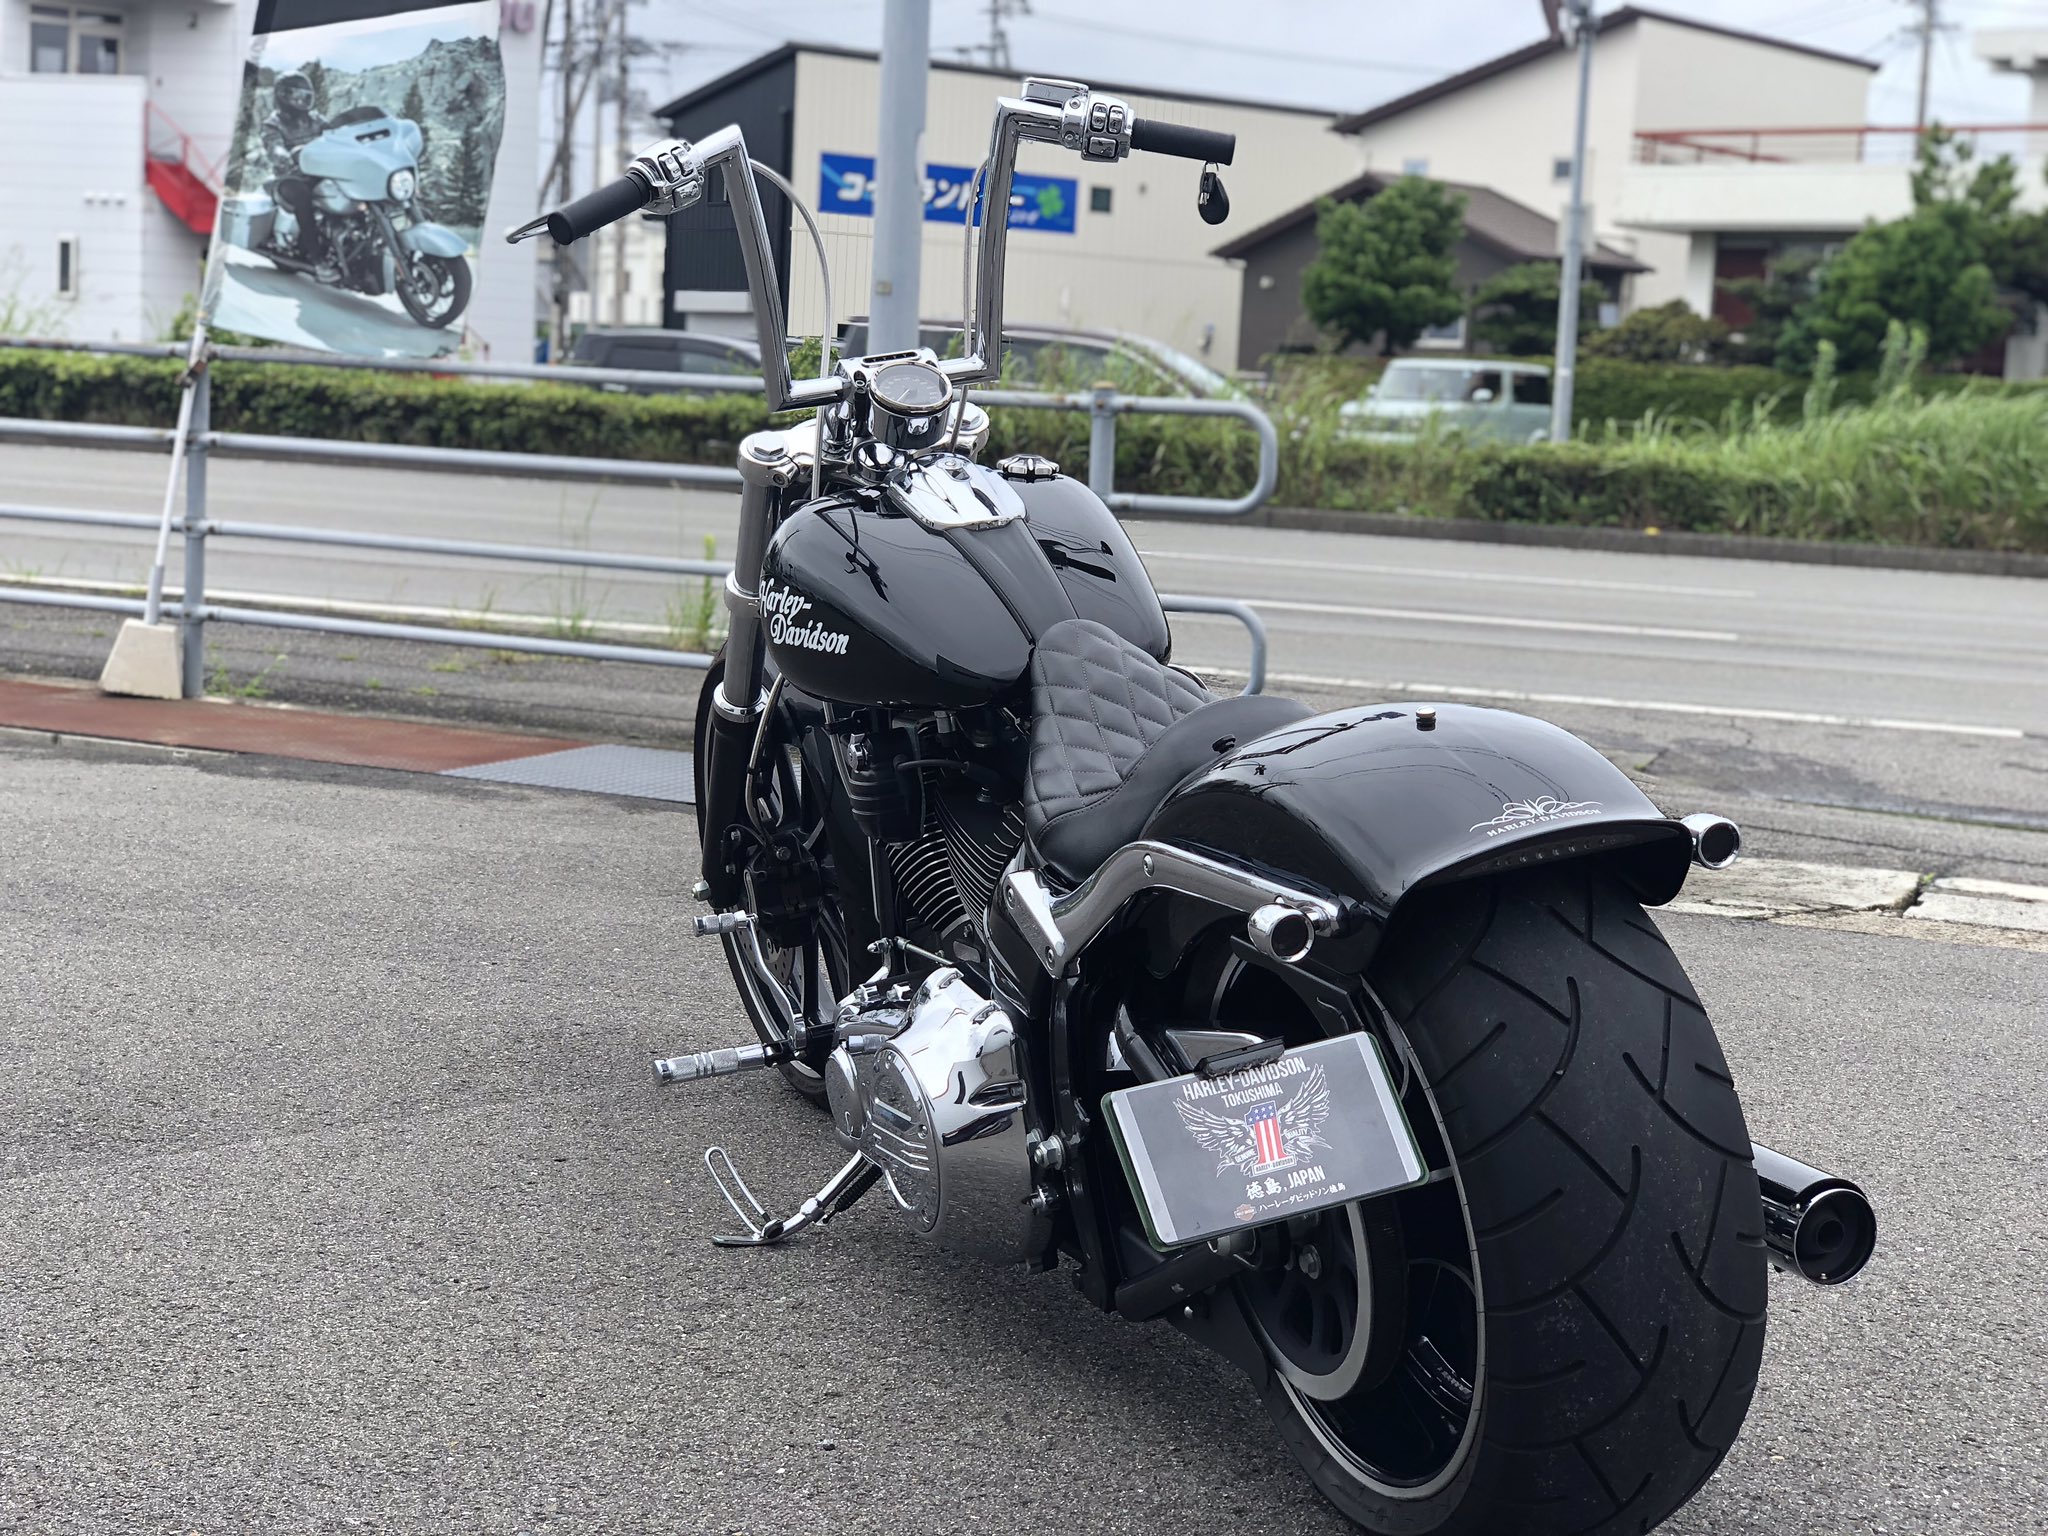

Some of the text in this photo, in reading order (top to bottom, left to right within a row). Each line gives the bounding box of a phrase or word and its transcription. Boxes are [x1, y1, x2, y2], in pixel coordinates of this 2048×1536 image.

[759, 577, 812, 626] Harley-
[770, 613, 850, 655] Davidson
[1486, 808, 1602, 838] HARLEY-DAVIDSON
[1221, 1082, 1284, 1108] TOKUSHIMA
[1287, 1165, 1326, 1189] JAPAN
